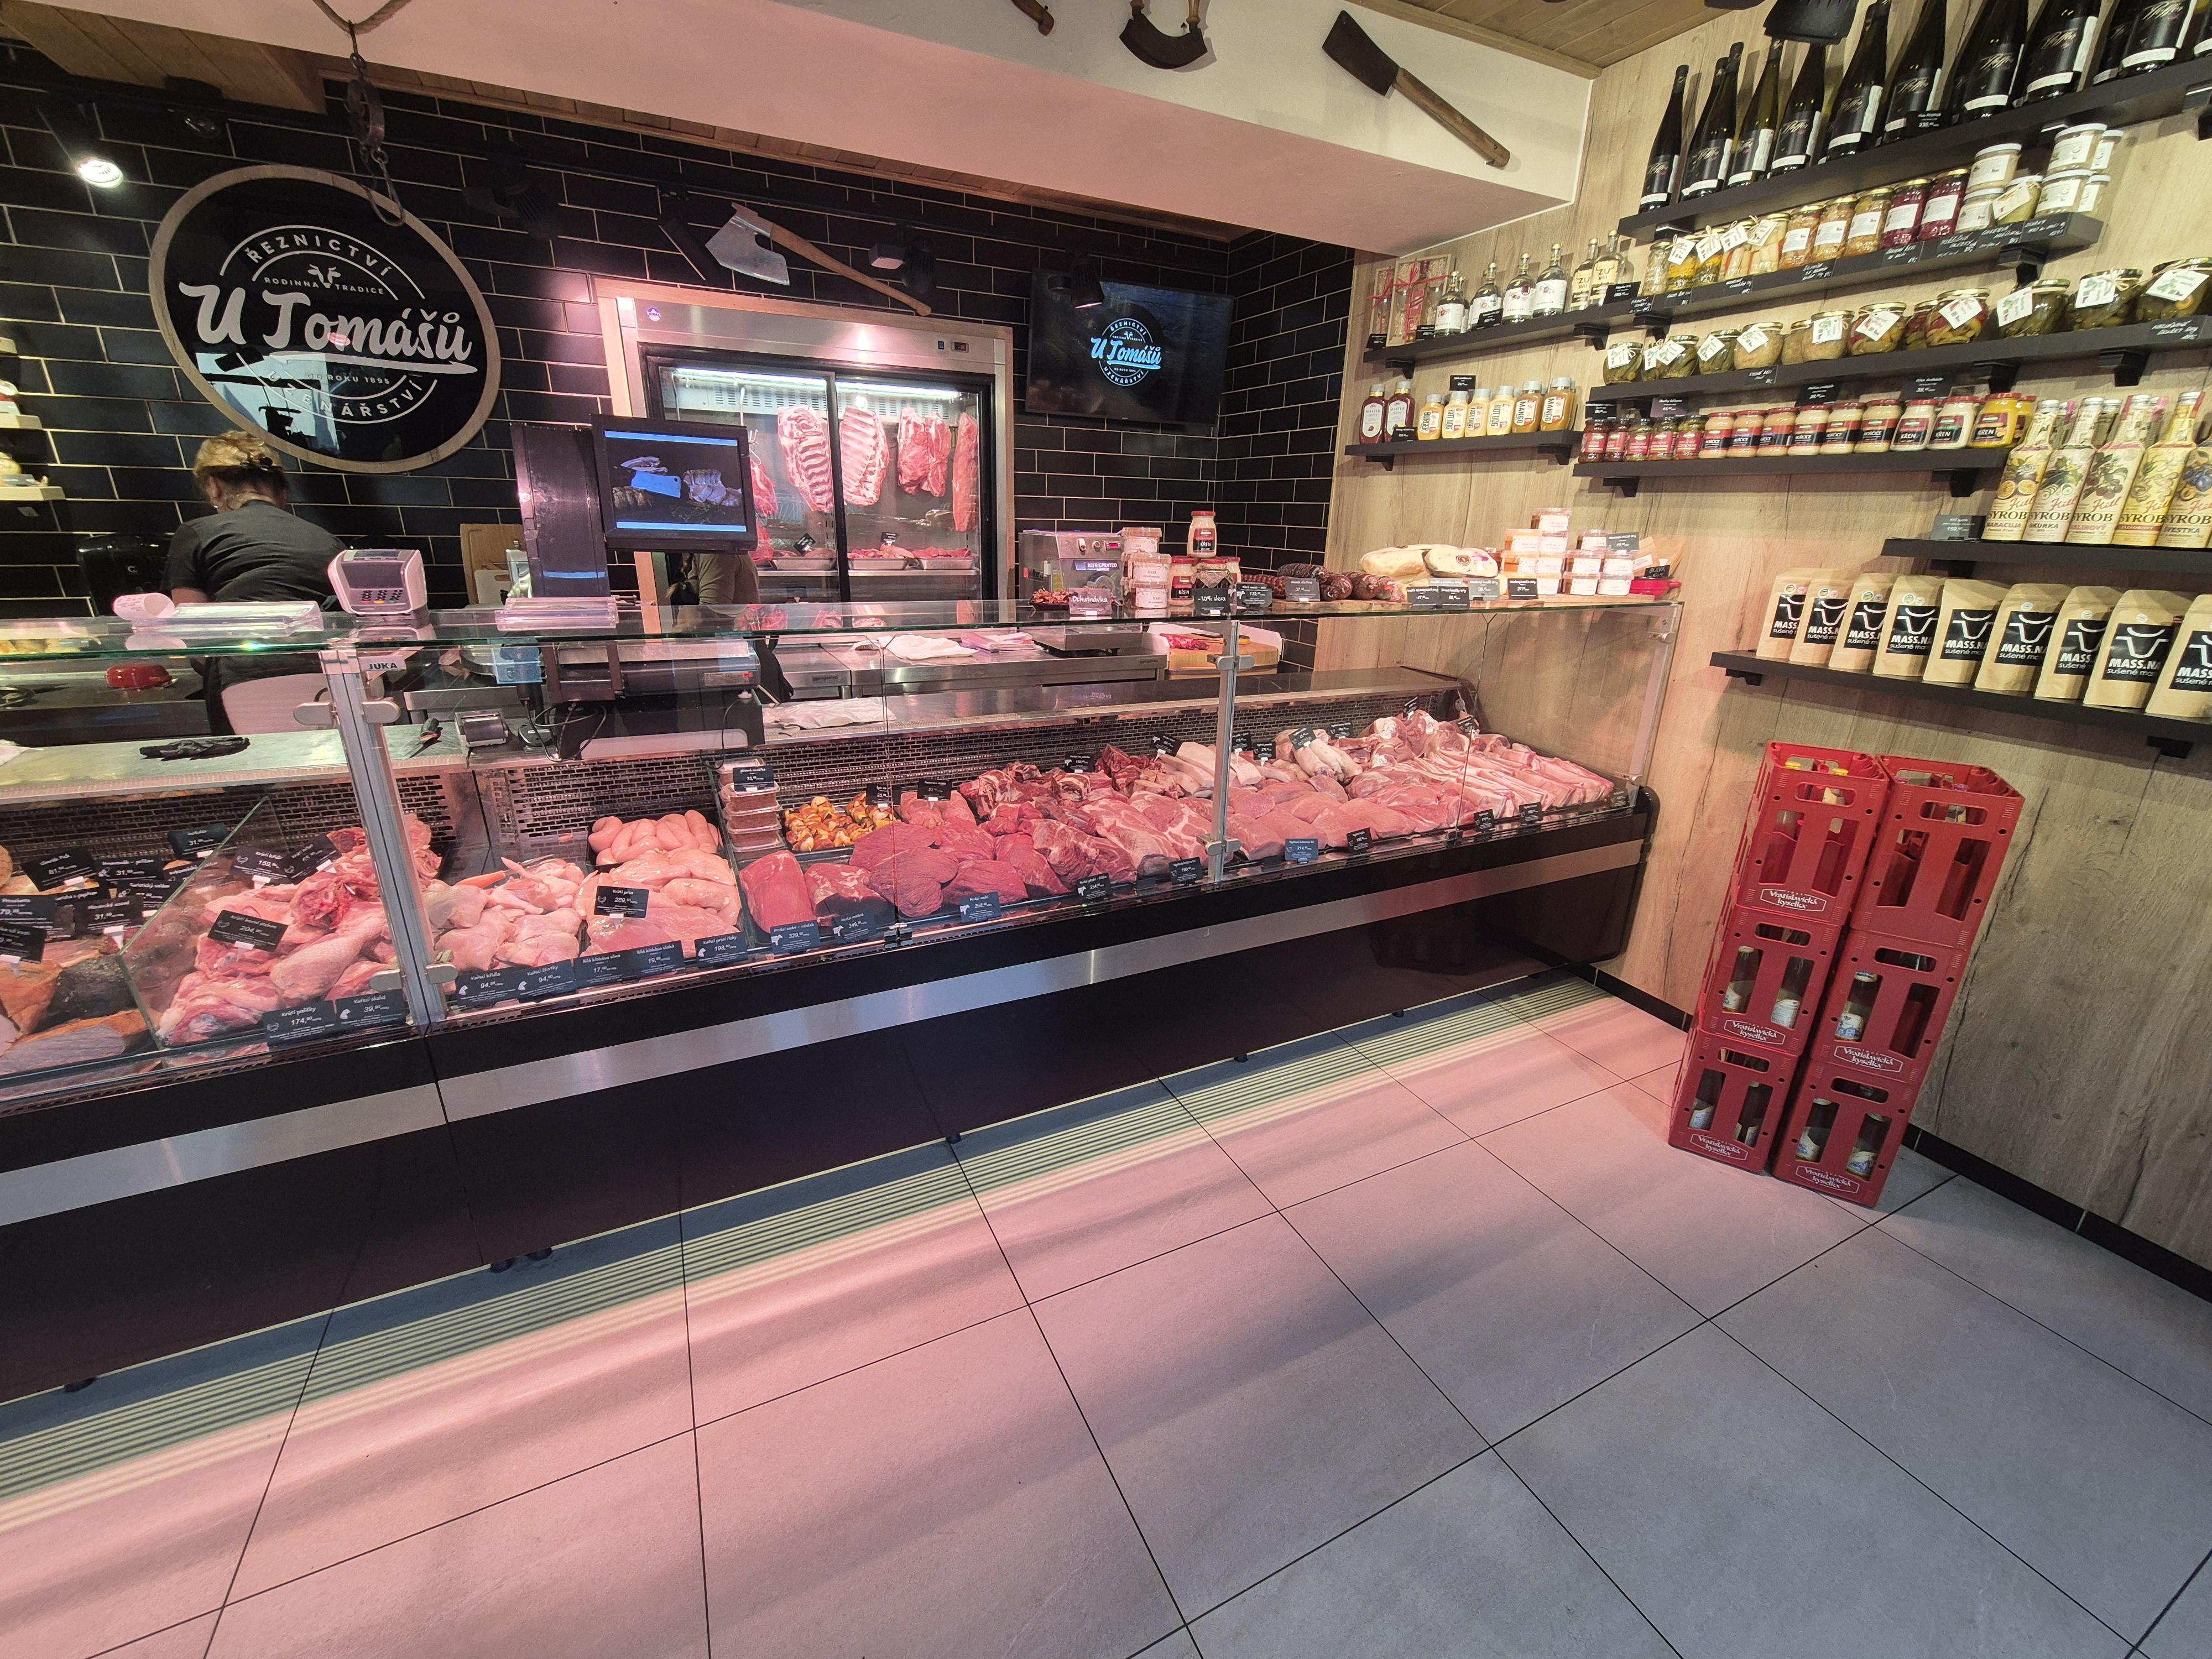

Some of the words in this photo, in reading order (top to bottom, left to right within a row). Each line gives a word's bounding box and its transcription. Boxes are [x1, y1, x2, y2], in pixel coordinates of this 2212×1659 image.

[245, 234, 393, 276] ŘEZNICTVÍ
[335, 284, 384, 295] TRADICE
[179, 281, 247, 345] U
[262, 292, 472, 362] Tomášů
[1091, 337, 1108, 359] U
[1107, 340, 1162, 364] Tomášů
[327, 374, 358, 382] ROKU
[268, 371, 423, 416] UZENÁŘSTVÍ
[1516, 401, 1526, 424] MANGO
[1544, 398, 1554, 421] MANGO
[1072, 595, 1108, 603] Ochutnávka
[368, 661, 398, 670] JUKA
[2107, 667, 2138, 676] sušené
